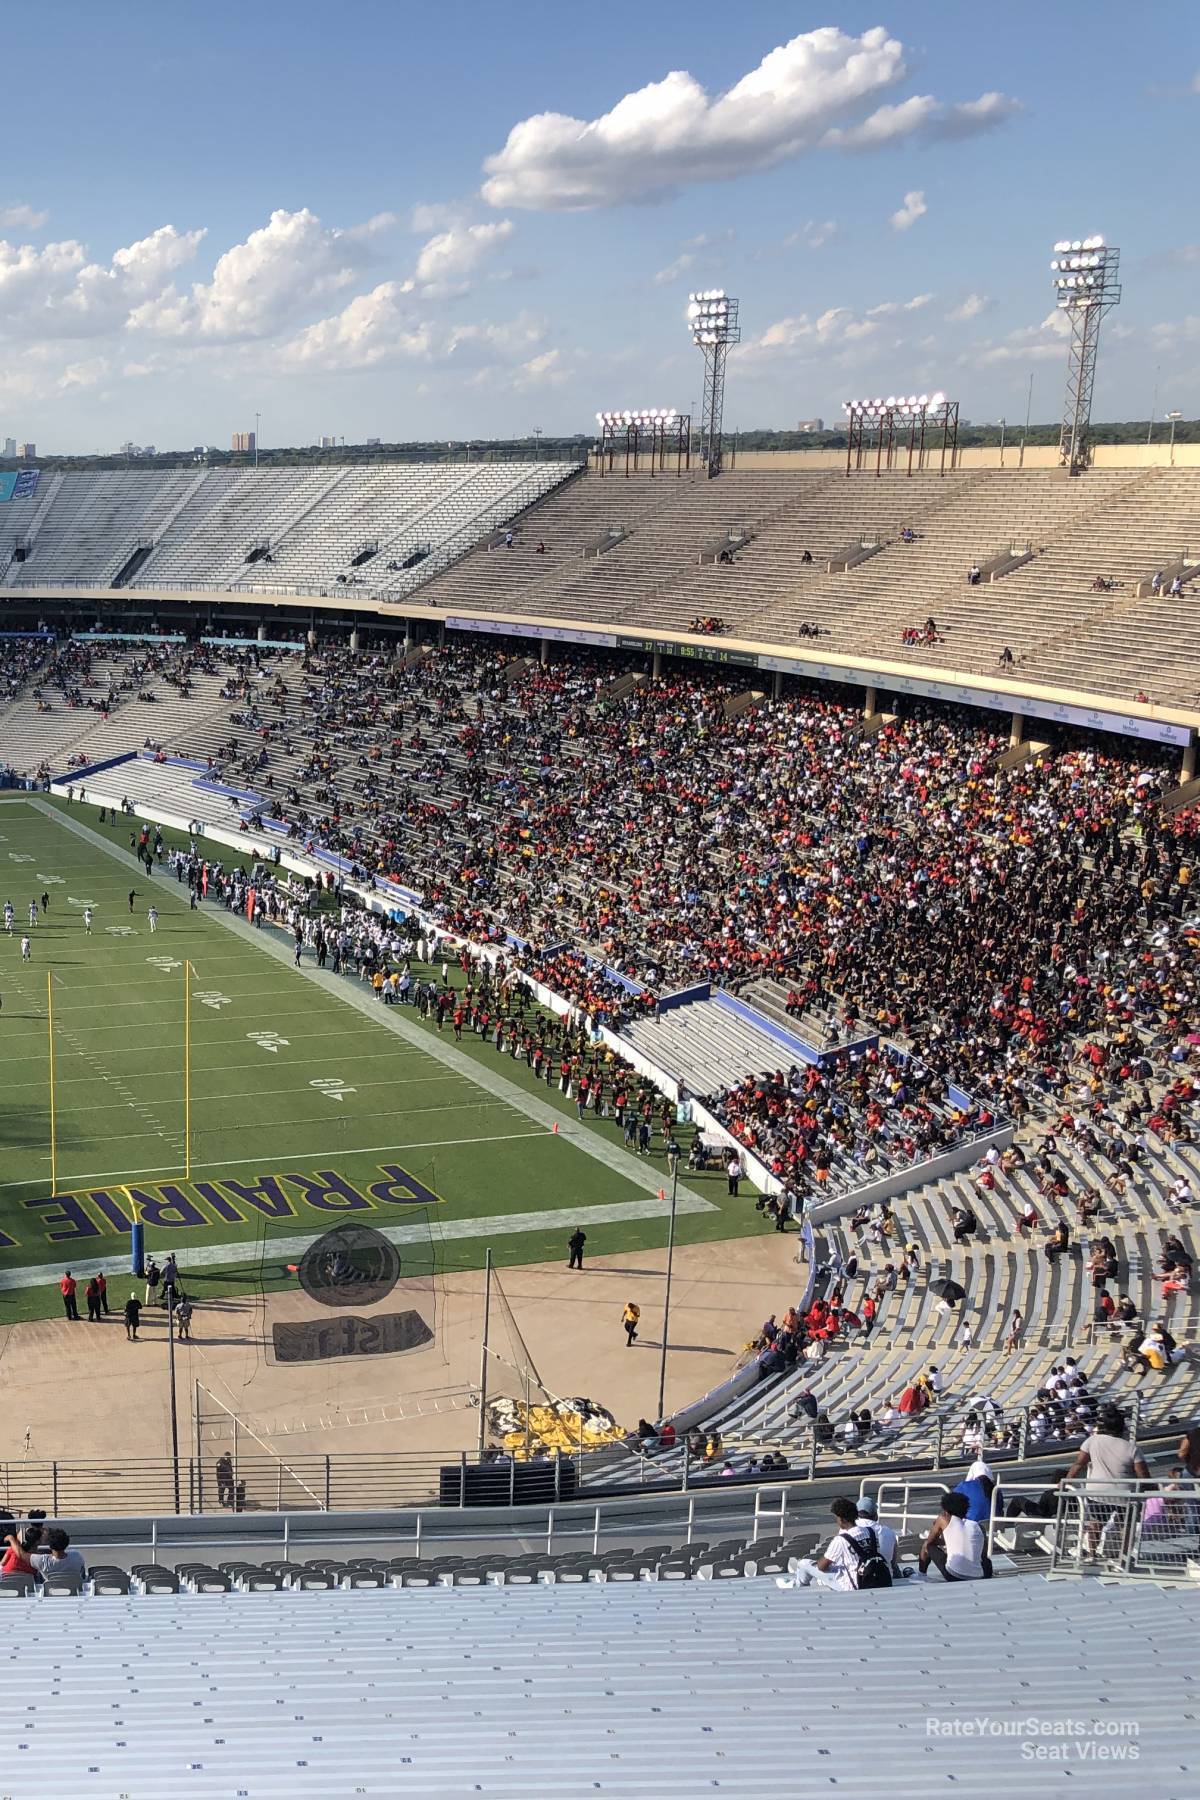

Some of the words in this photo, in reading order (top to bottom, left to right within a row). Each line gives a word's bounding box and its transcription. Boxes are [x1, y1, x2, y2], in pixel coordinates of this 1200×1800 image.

[192, 990, 233, 1005] 30
[246, 1031, 291, 1047] 20
[308, 1078, 358, 1096] 10
[21, 1162, 447, 1243] PRAIRIE
